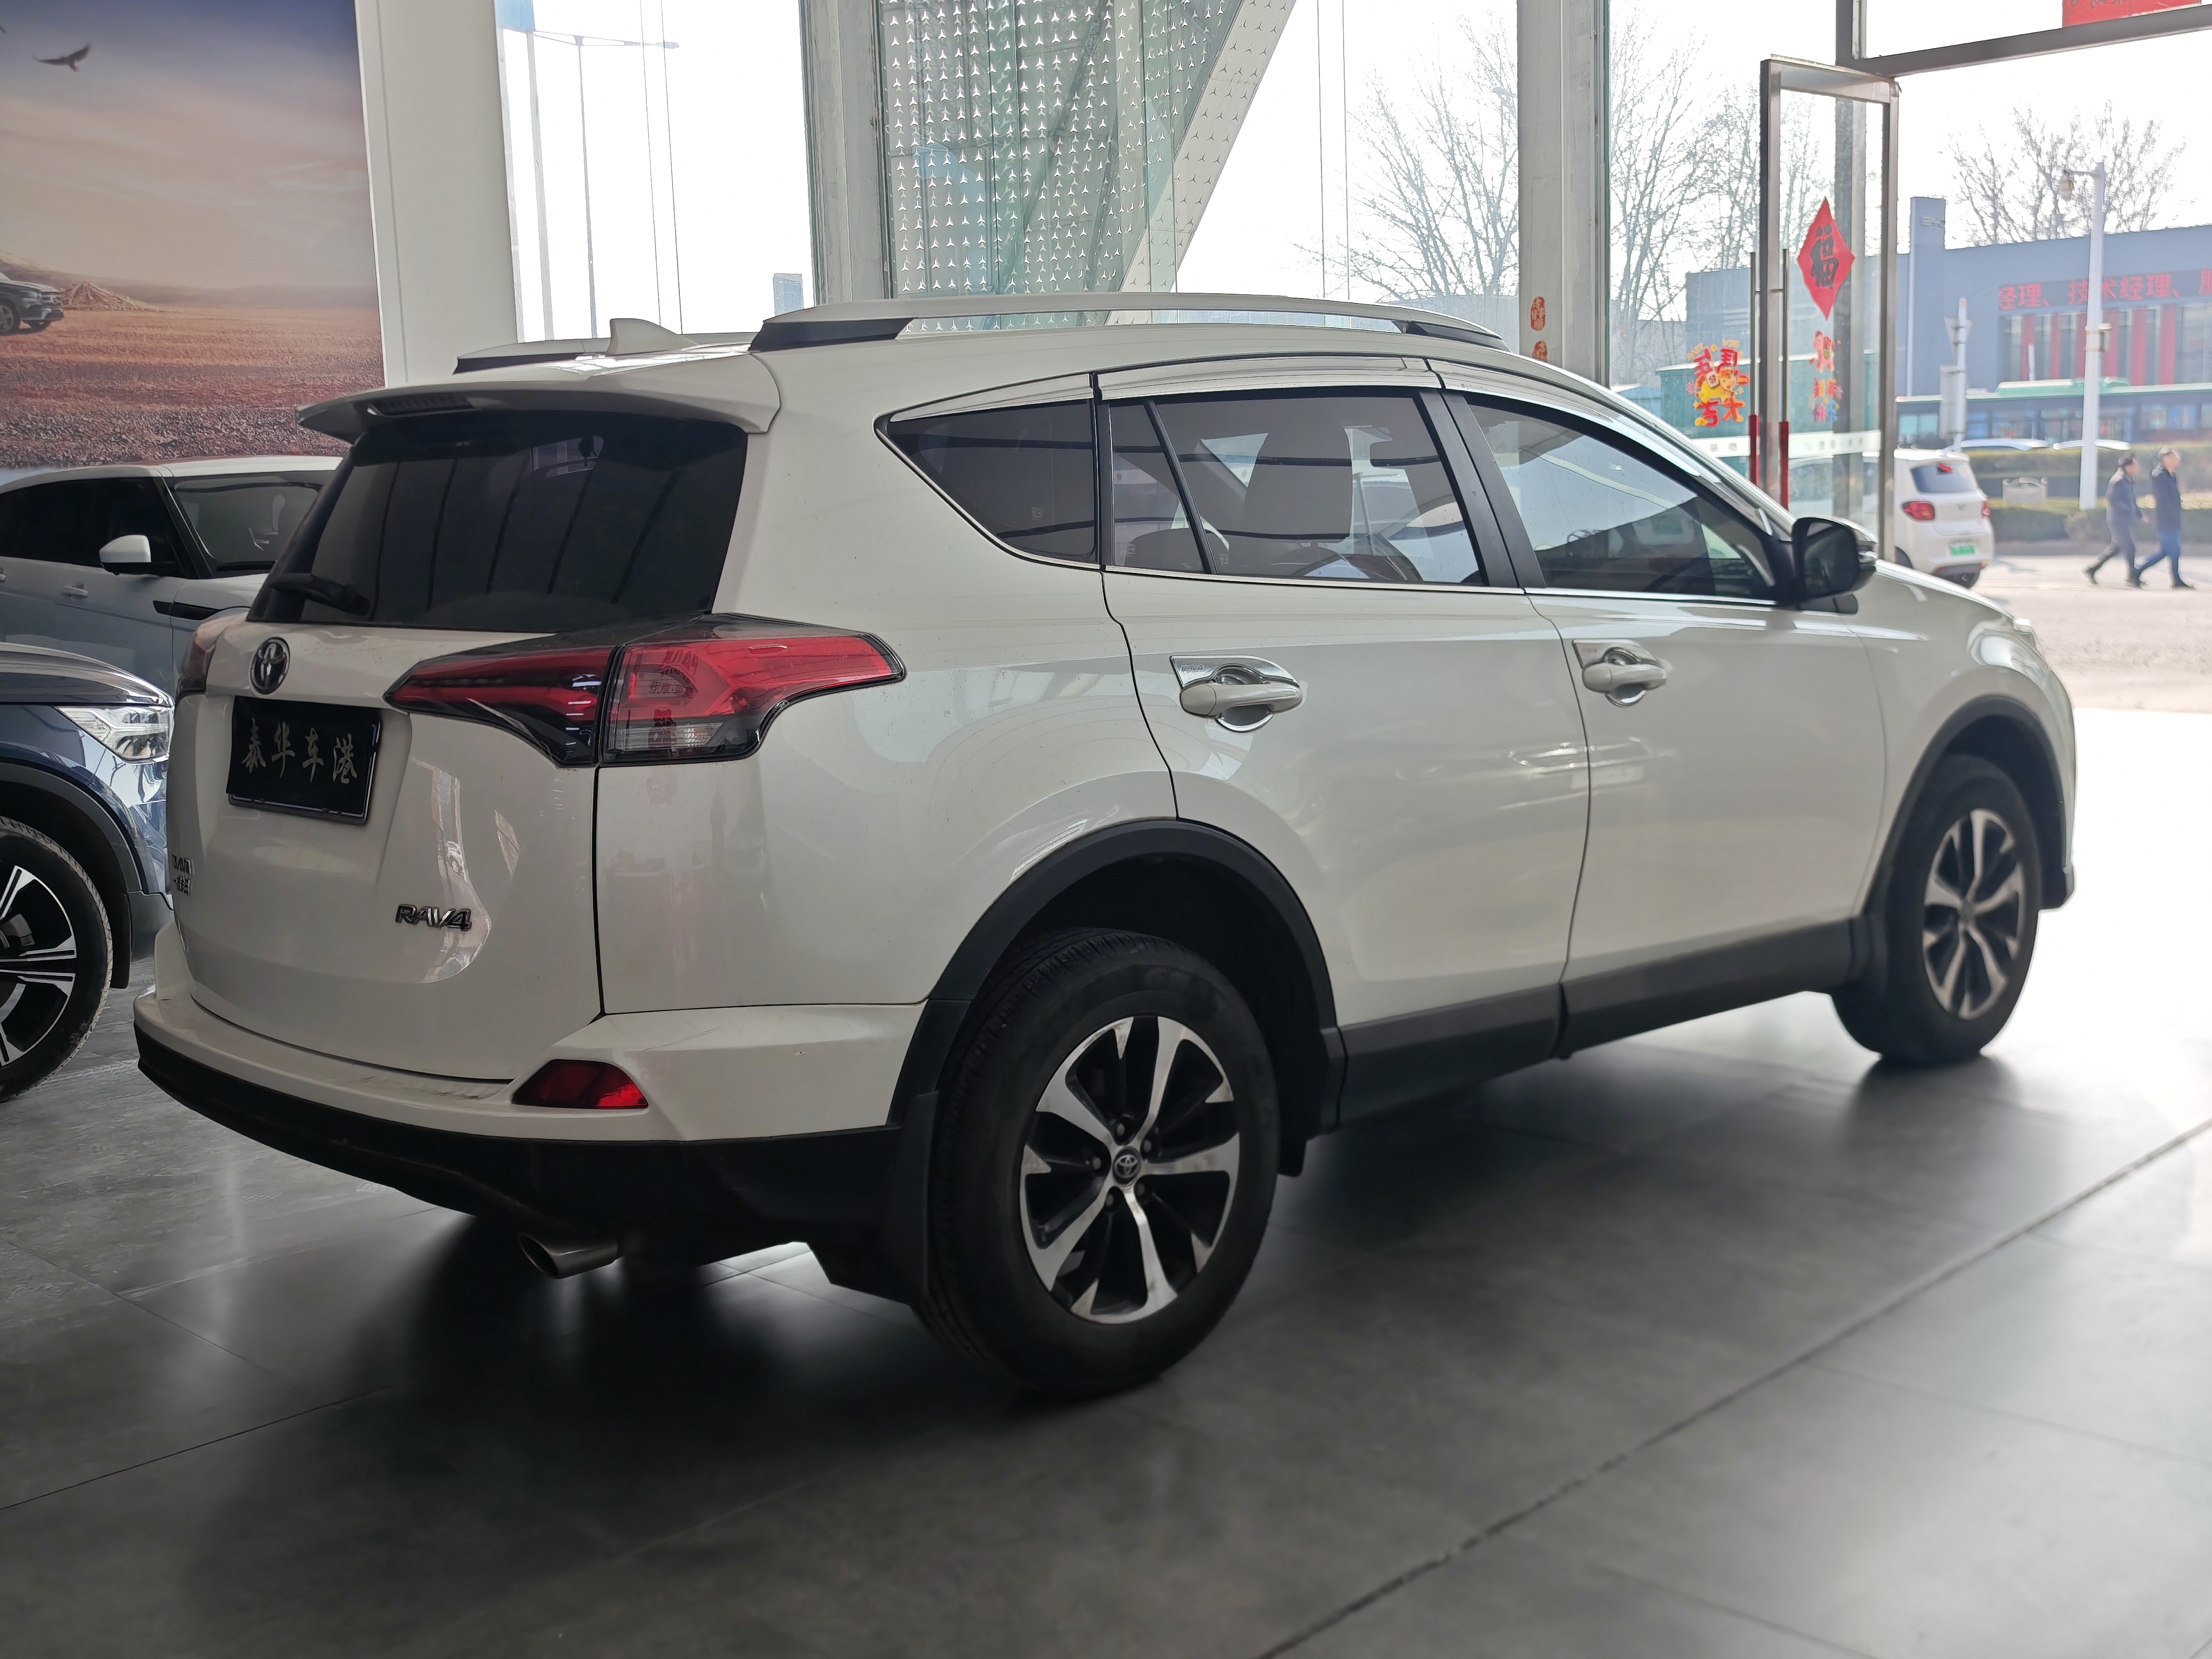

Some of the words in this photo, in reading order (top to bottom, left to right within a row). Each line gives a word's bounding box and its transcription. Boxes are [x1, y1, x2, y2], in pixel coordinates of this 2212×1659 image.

[1810, 224, 1839, 289] 福
[241, 717, 358, 784] 泰华车港
[172, 854, 194, 876] TOYOTA
[395, 903, 473, 932] RAV4
